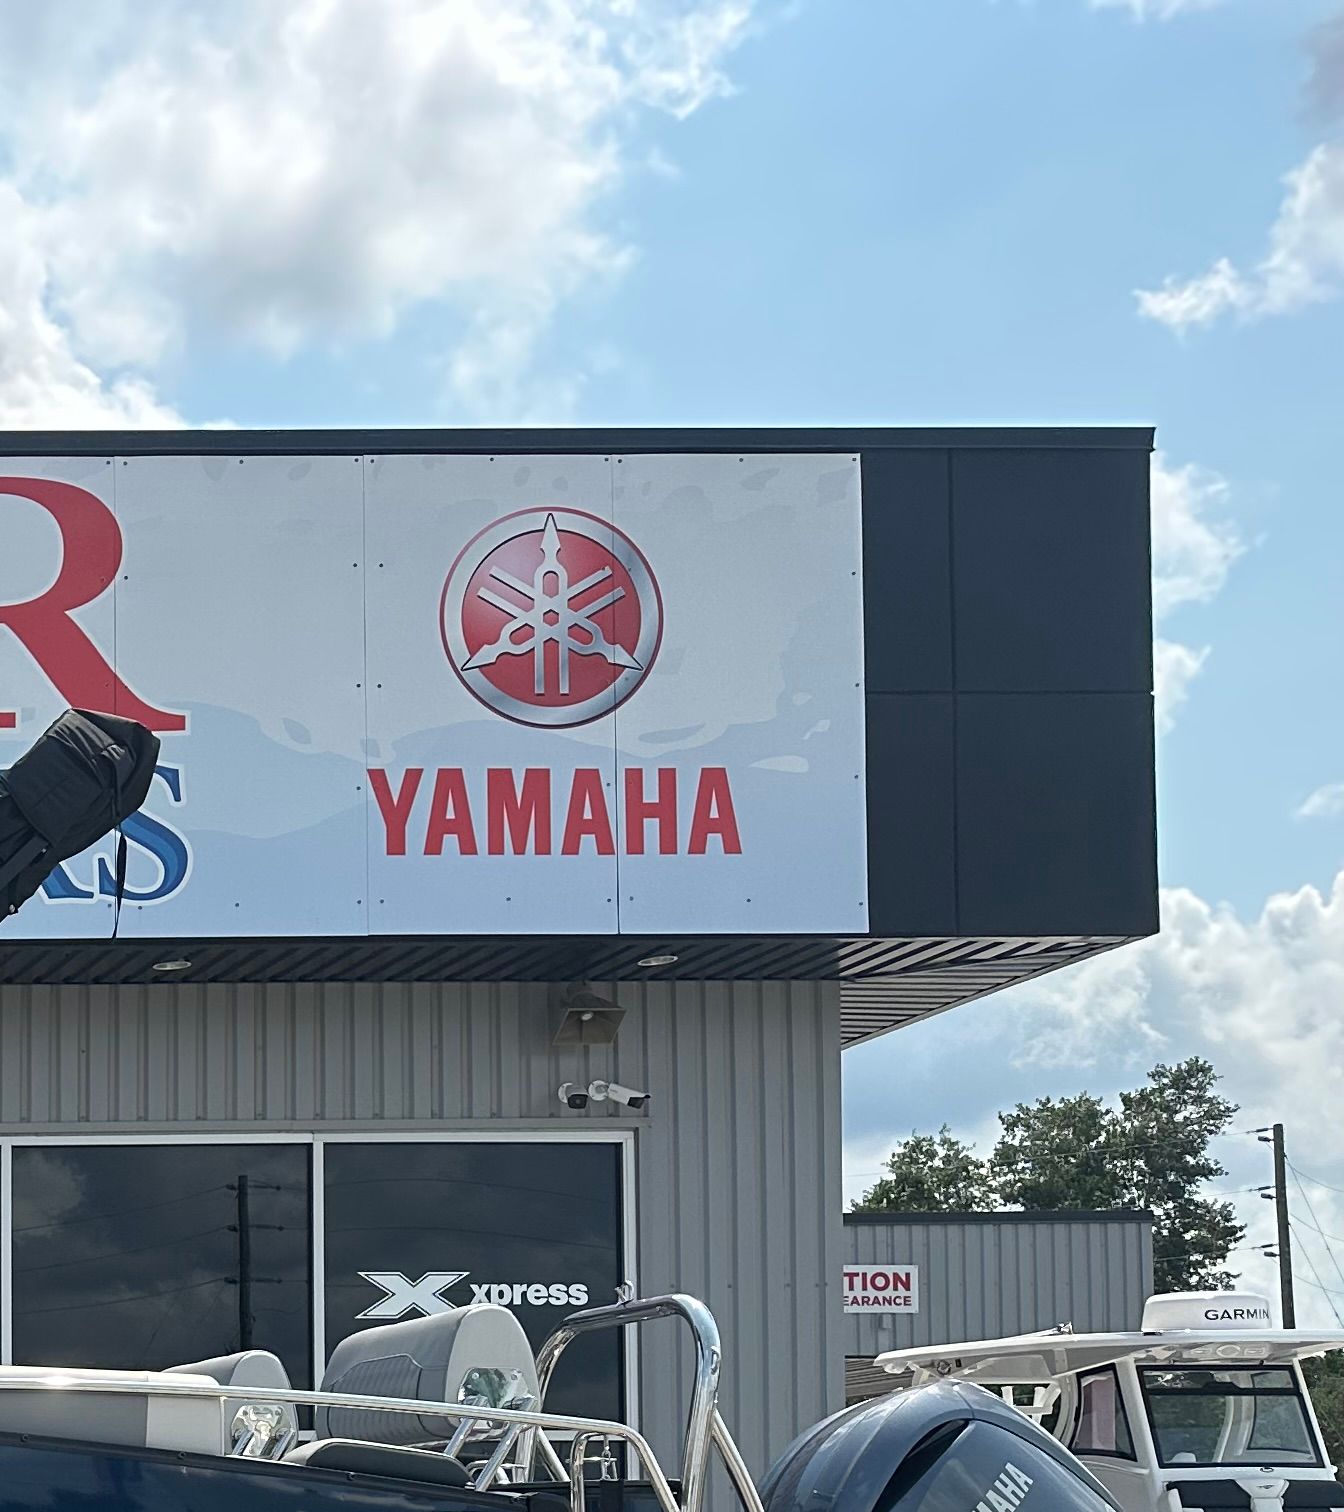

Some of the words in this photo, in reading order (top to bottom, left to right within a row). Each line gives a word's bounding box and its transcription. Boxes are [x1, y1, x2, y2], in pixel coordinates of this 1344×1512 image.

[366, 767, 743, 856] YAMAHA
[469, 1281, 589, 1306] xpress
[1204, 1308, 1270, 1321] GARMIN
